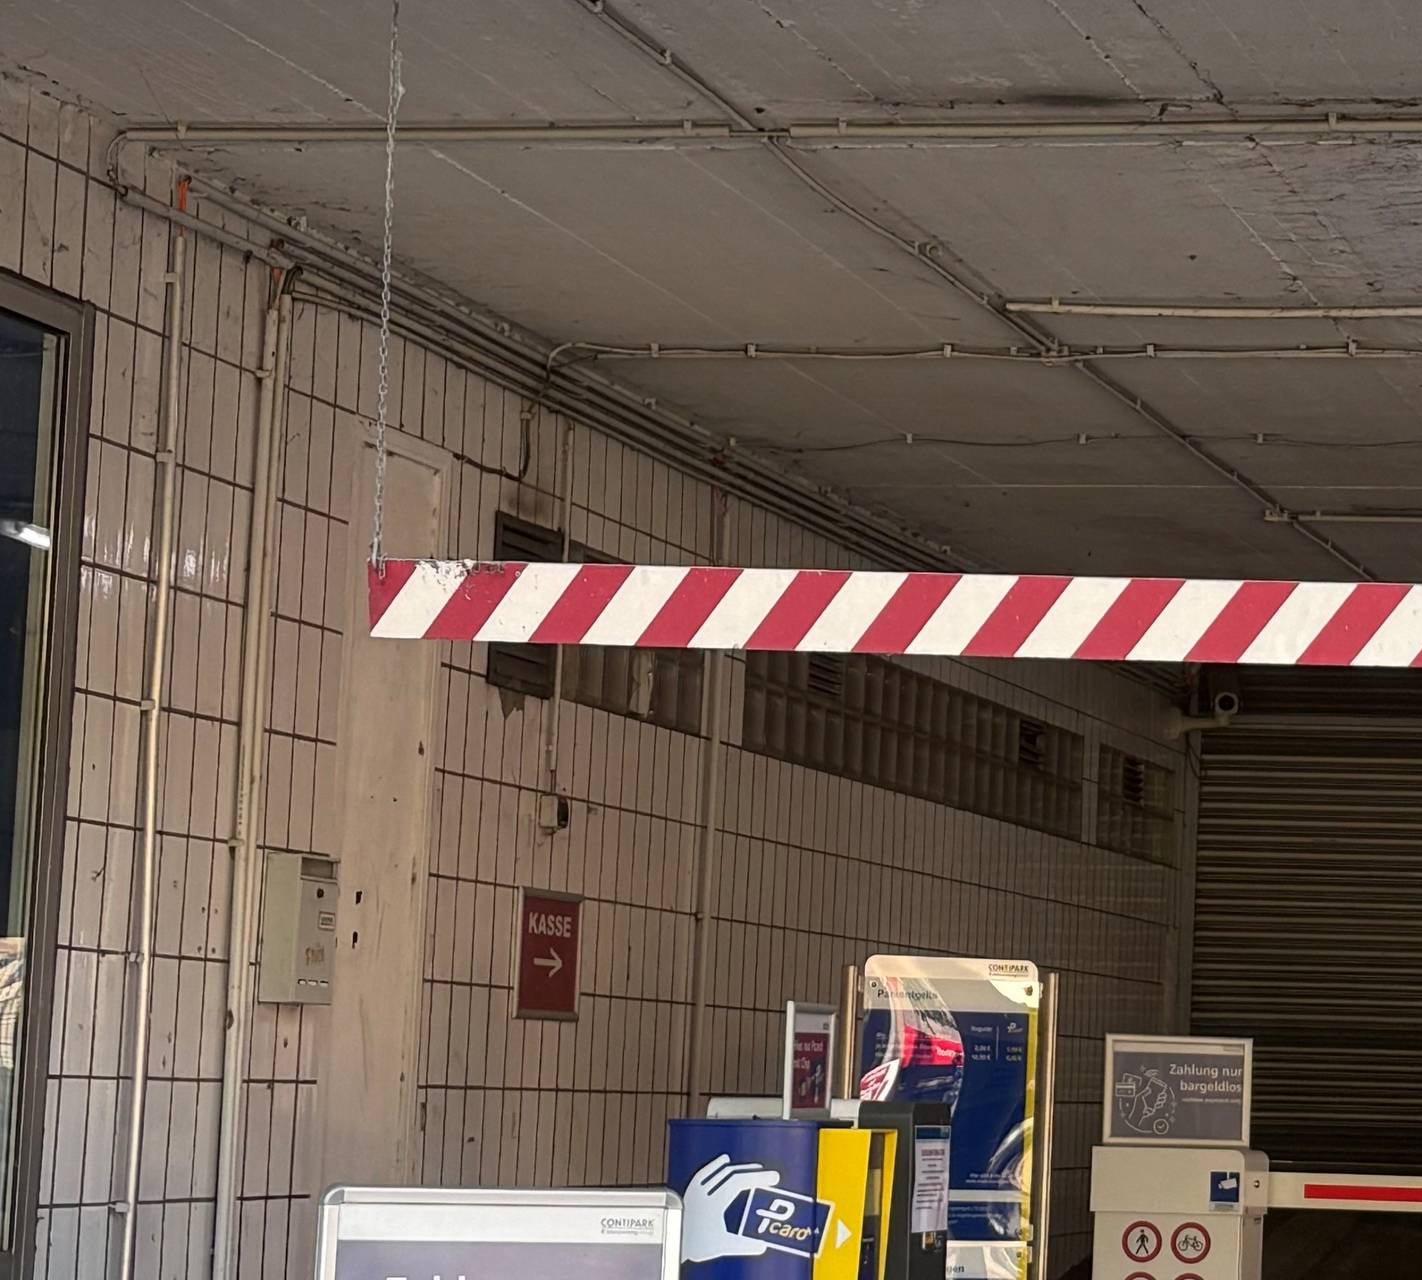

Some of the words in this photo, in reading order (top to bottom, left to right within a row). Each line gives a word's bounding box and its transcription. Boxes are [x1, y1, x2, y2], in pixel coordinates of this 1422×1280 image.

[529, 911, 572, 938] KASSE
[1169, 1064, 1218, 1078] Zahlung
[1222, 1067, 1242, 1077] nur
[1180, 1080, 1242, 1094] bargeldlos
[600, 1217, 655, 1228] CONTIPARK
